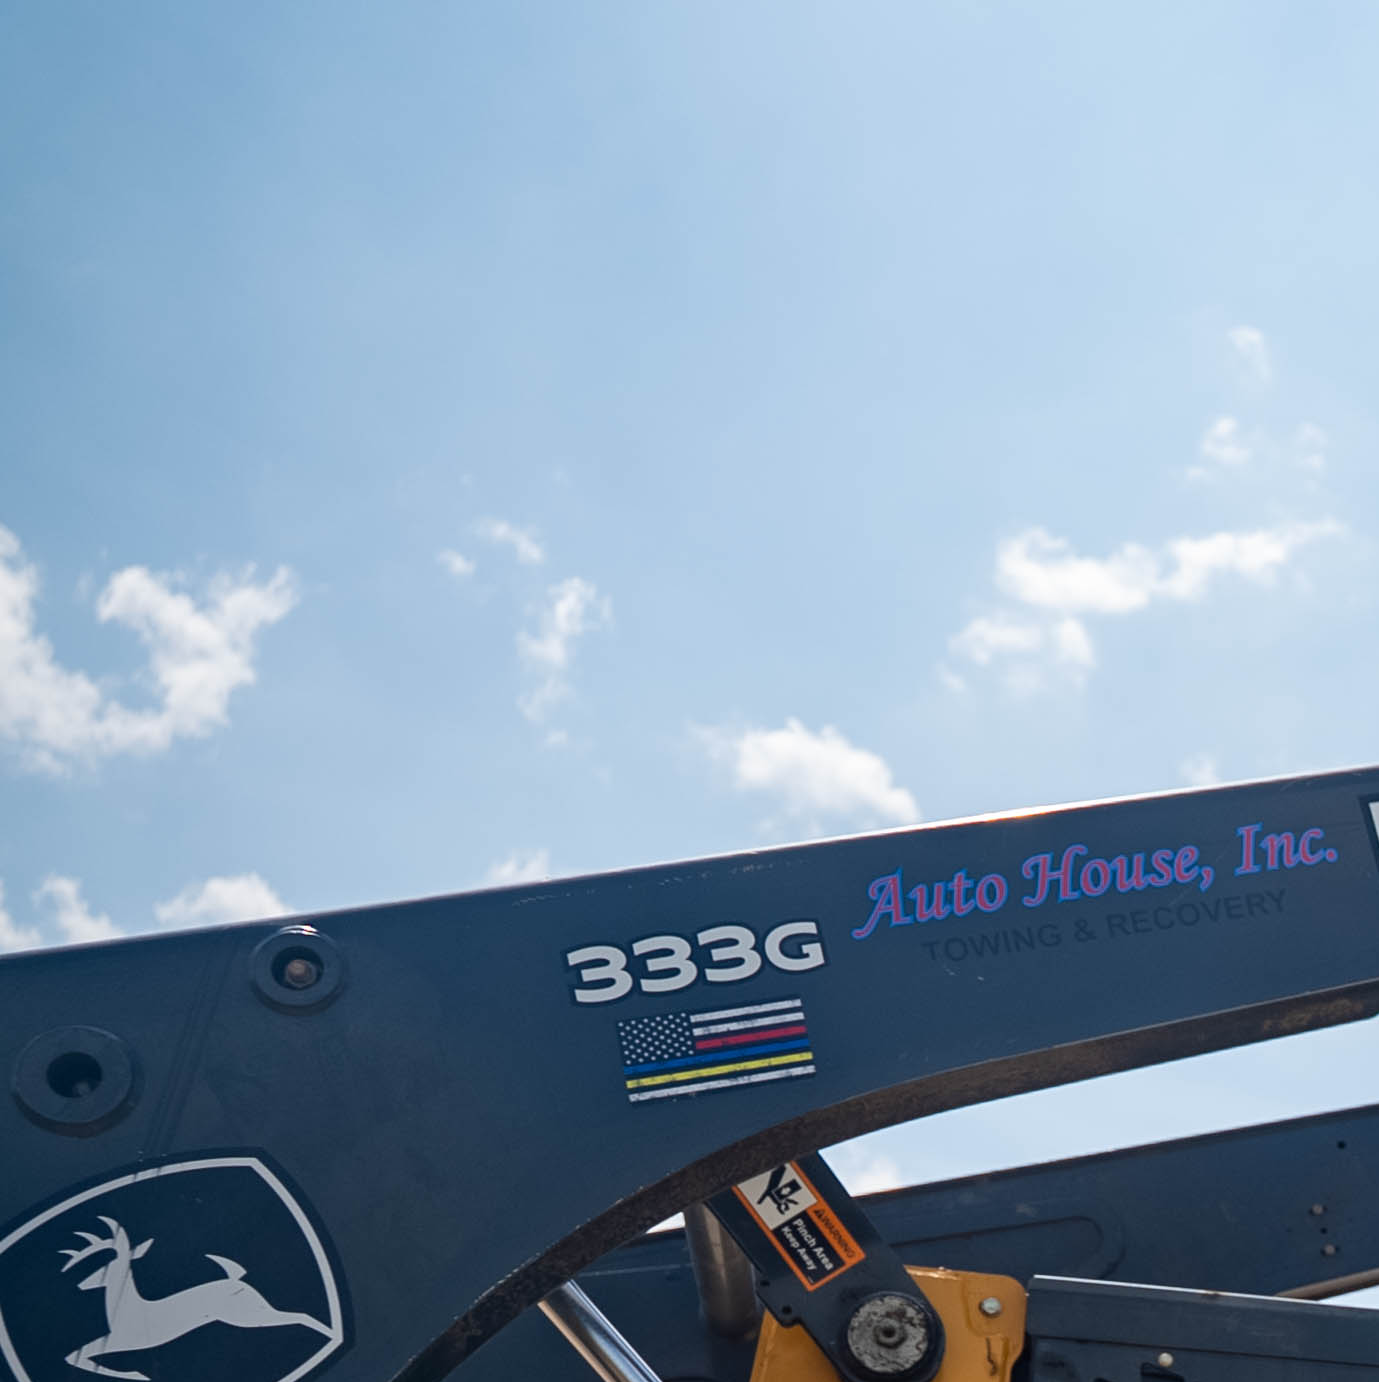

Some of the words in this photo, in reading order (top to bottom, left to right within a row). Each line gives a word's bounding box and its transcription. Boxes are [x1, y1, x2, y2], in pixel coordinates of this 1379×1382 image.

[852, 868, 1007, 940] Auto
[1022, 842, 1215, 908] House,
[1235, 823, 1338, 875] Inc.
[567, 921, 826, 1004] 333G
[921, 923, 1062, 964] TOWING
[1073, 918, 1098, 944] &
[1105, 888, 1289, 939] RECOVERY
[781, 1226, 801, 1249] Keep
[797, 1247, 817, 1271] Away
[792, 1217, 818, 1248] Pinch
[812, 1245, 835, 1271] Area
